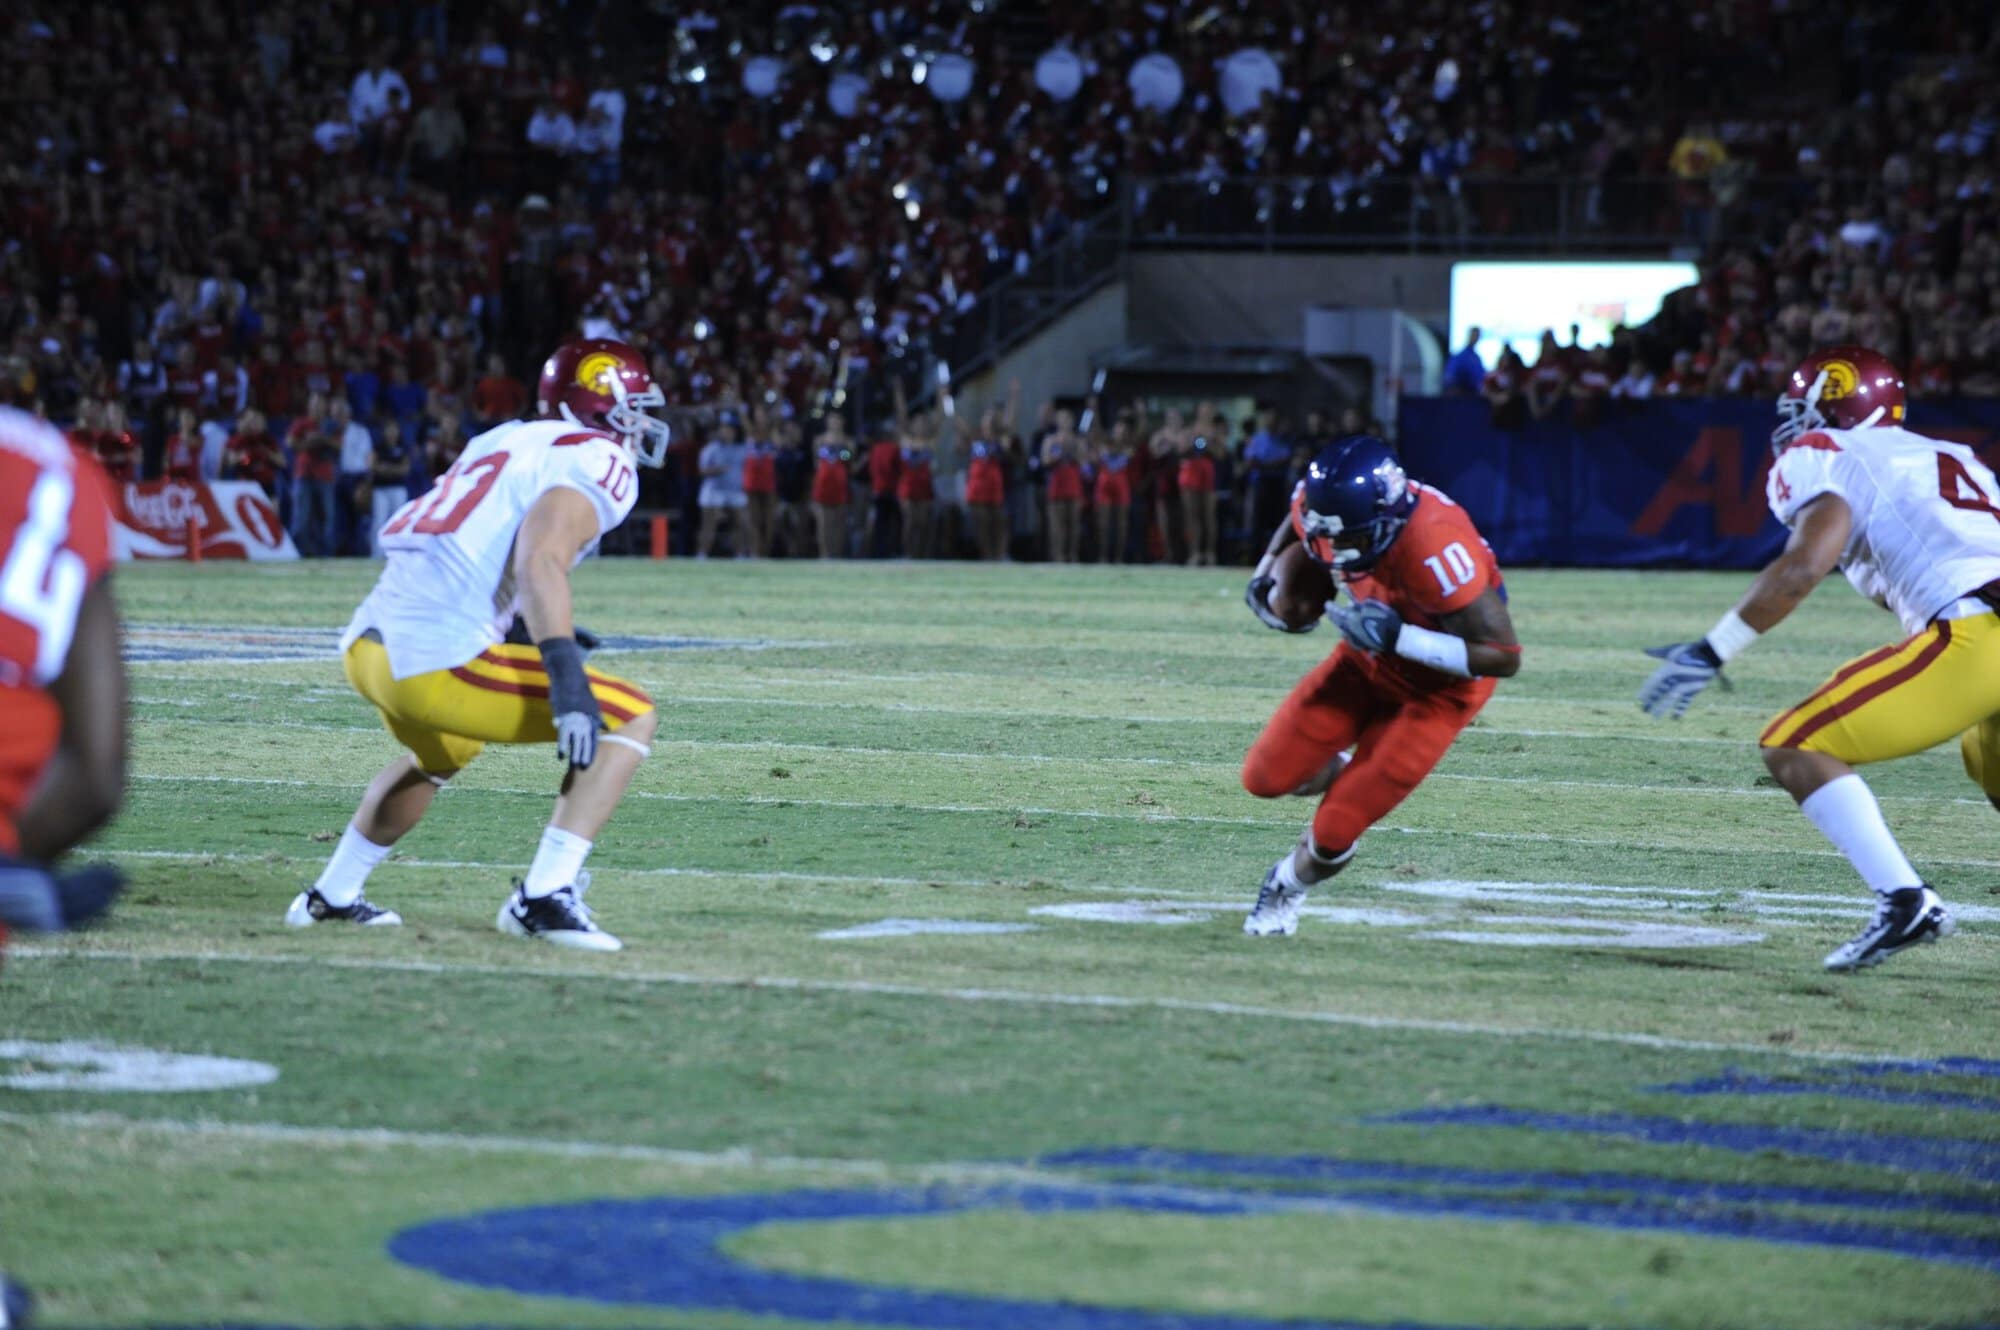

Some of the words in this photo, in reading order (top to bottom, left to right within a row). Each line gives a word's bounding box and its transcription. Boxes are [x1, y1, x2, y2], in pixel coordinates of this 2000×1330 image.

[597, 454, 632, 502] 10
[1775, 468, 1792, 503] 4
[1423, 541, 1476, 598] 10
